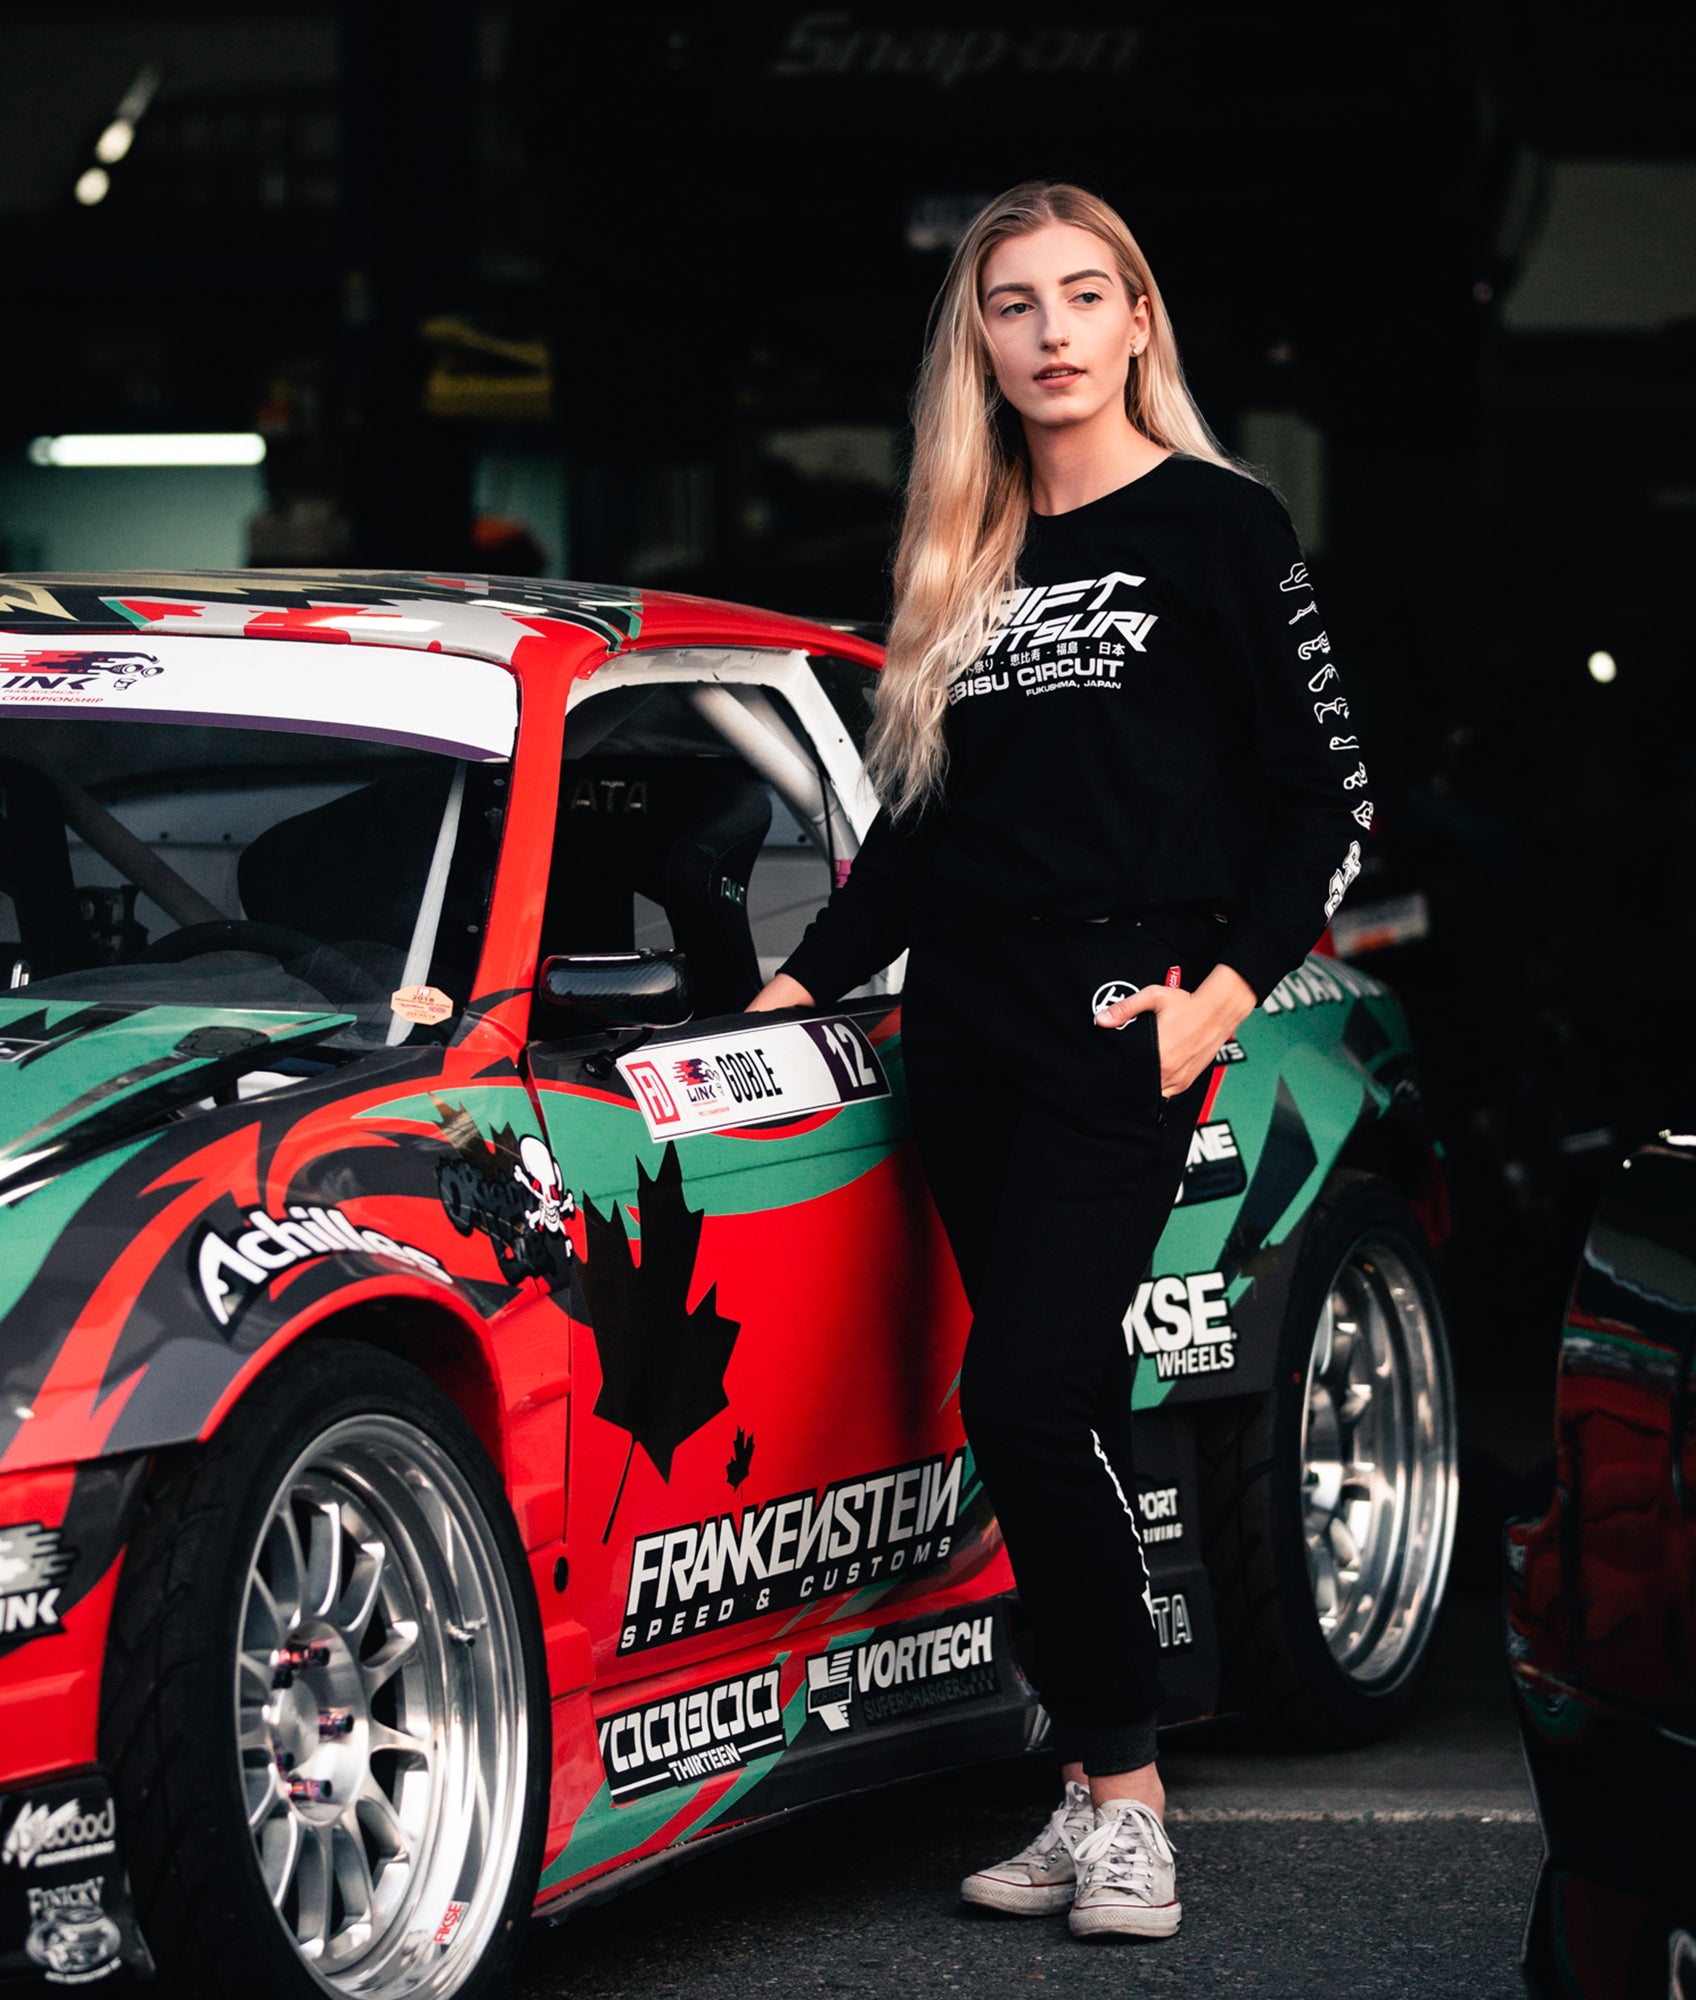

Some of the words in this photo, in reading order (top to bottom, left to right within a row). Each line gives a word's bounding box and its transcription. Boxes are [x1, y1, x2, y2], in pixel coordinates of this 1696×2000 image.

[1056, 641, 1079, 656] 福島
[1099, 641, 1126, 657] 日本
[1017, 658, 1124, 687] CIRCUIT
[1026, 679, 1081, 697] FUKUSHIMA,
[1083, 679, 1122, 689] JAPAN
[1, 695, 104, 703] CHAMPIONSHIP
[560, 776, 648, 816] ATA
[821, 1022, 878, 1088] 12
[198, 1205, 454, 1326] Achilles
[1156, 1342, 1235, 1378] WHEELS
[626, 1455, 964, 1616] FRANKENSTEIN
[620, 1596, 735, 1650] SPEED
[755, 1587, 771, 1611] &
[799, 1535, 952, 1599] CUSTOMS
[856, 1616, 994, 1694] VORTECH
[667, 1742, 742, 1782] THIRTEEN
